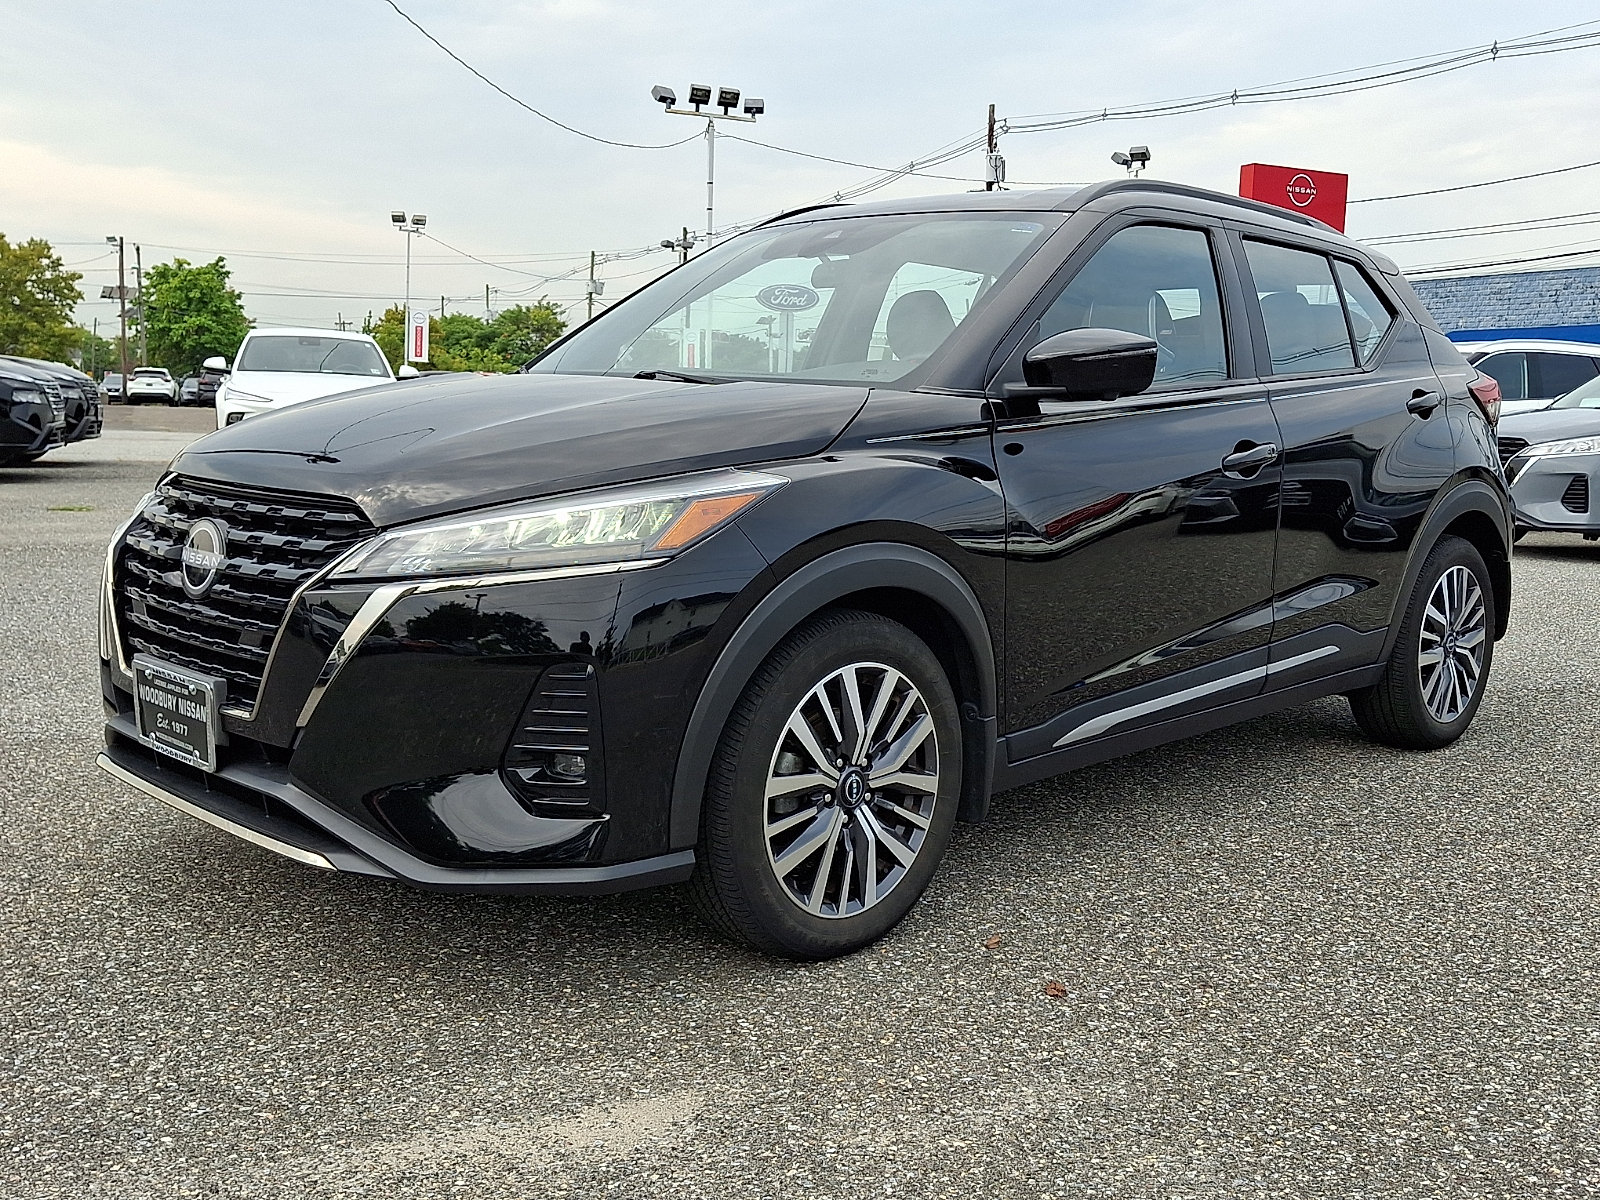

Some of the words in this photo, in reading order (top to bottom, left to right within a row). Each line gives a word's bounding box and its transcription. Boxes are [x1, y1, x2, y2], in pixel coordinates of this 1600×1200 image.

[1286, 185, 1317, 195] NISSAN
[770, 288, 808, 306] Ford
[181, 547, 221, 567] NISSAN
[139, 684, 177, 712] WOODBURY
[178, 697, 207, 723] NISSAN
[156, 713, 171, 729] Est.
[171, 721, 188, 736] 1977
